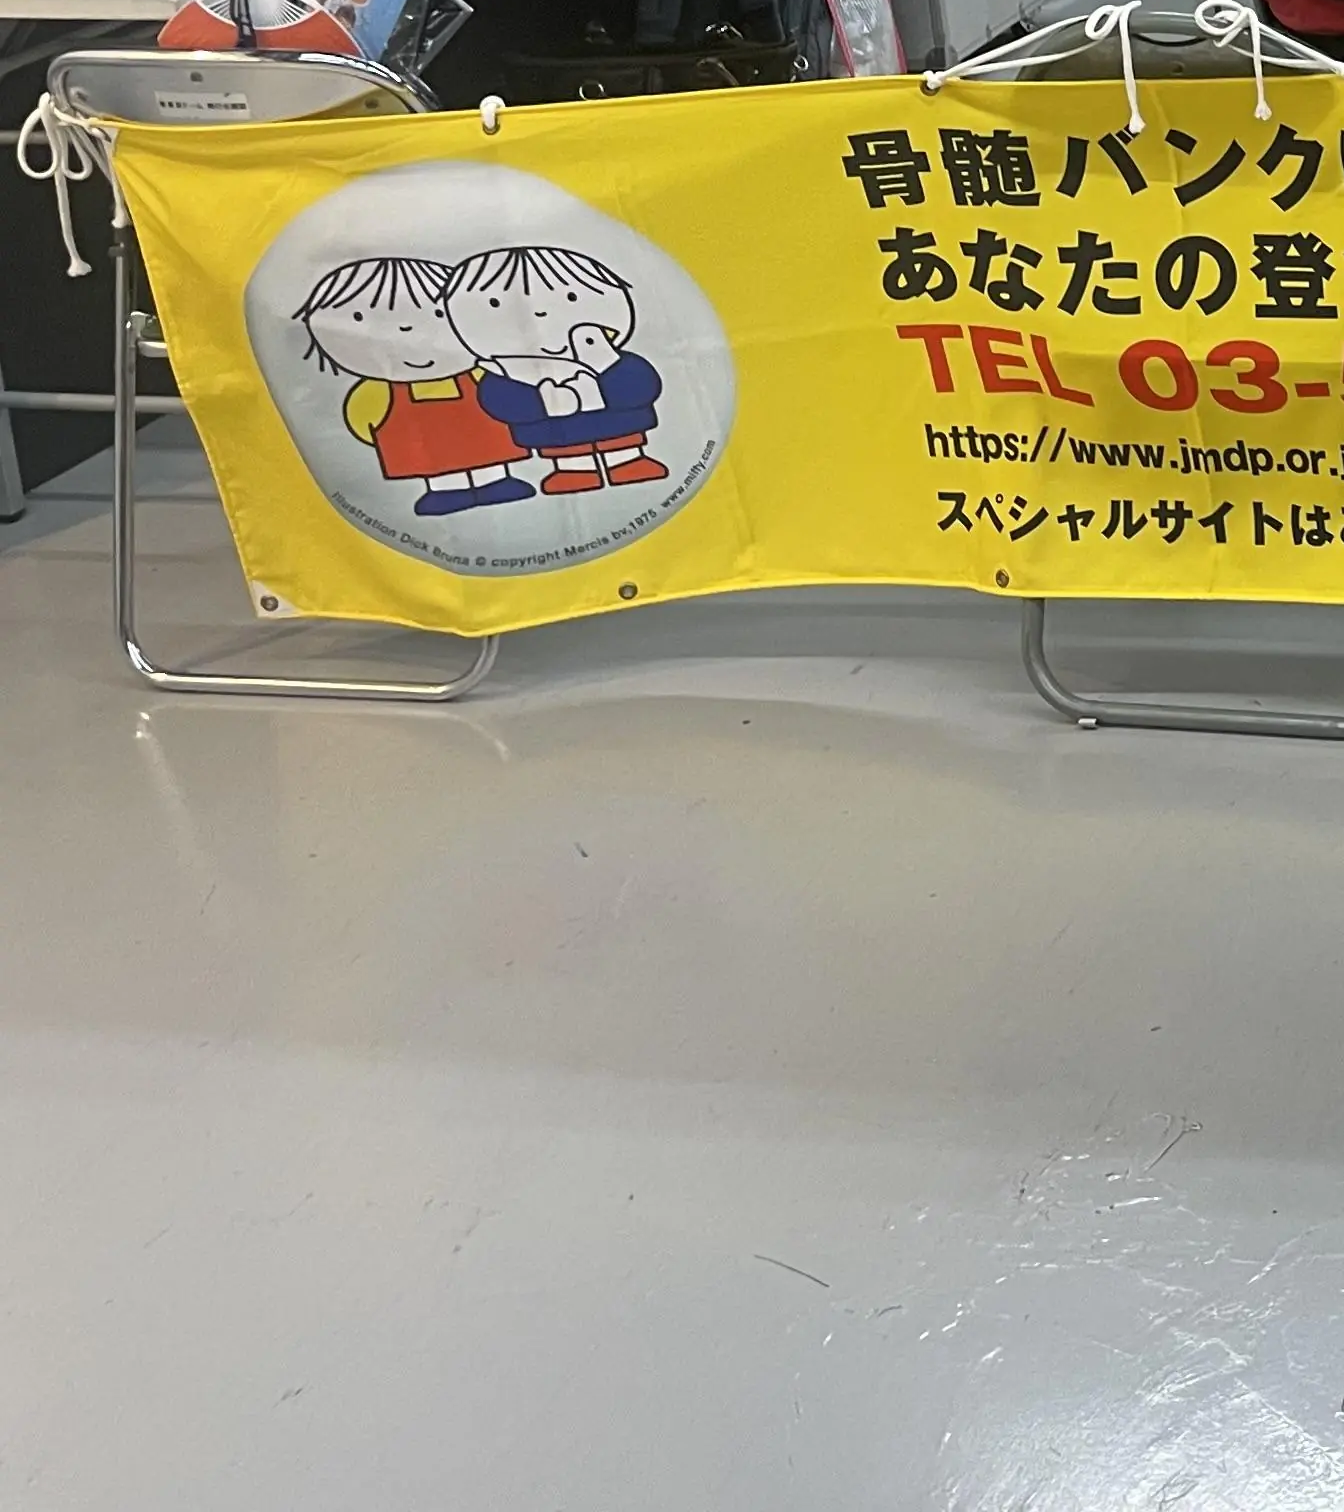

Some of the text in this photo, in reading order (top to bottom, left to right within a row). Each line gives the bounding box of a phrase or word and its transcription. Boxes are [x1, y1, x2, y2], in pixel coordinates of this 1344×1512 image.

[896, 324, 1094, 406] TEL
[332, 491, 396, 538] Illustration
[400, 532, 429, 553] Dick
[432, 546, 470, 567] Bruna
[491, 547, 561, 569] copyright
[564, 536, 610, 557] Mercis
